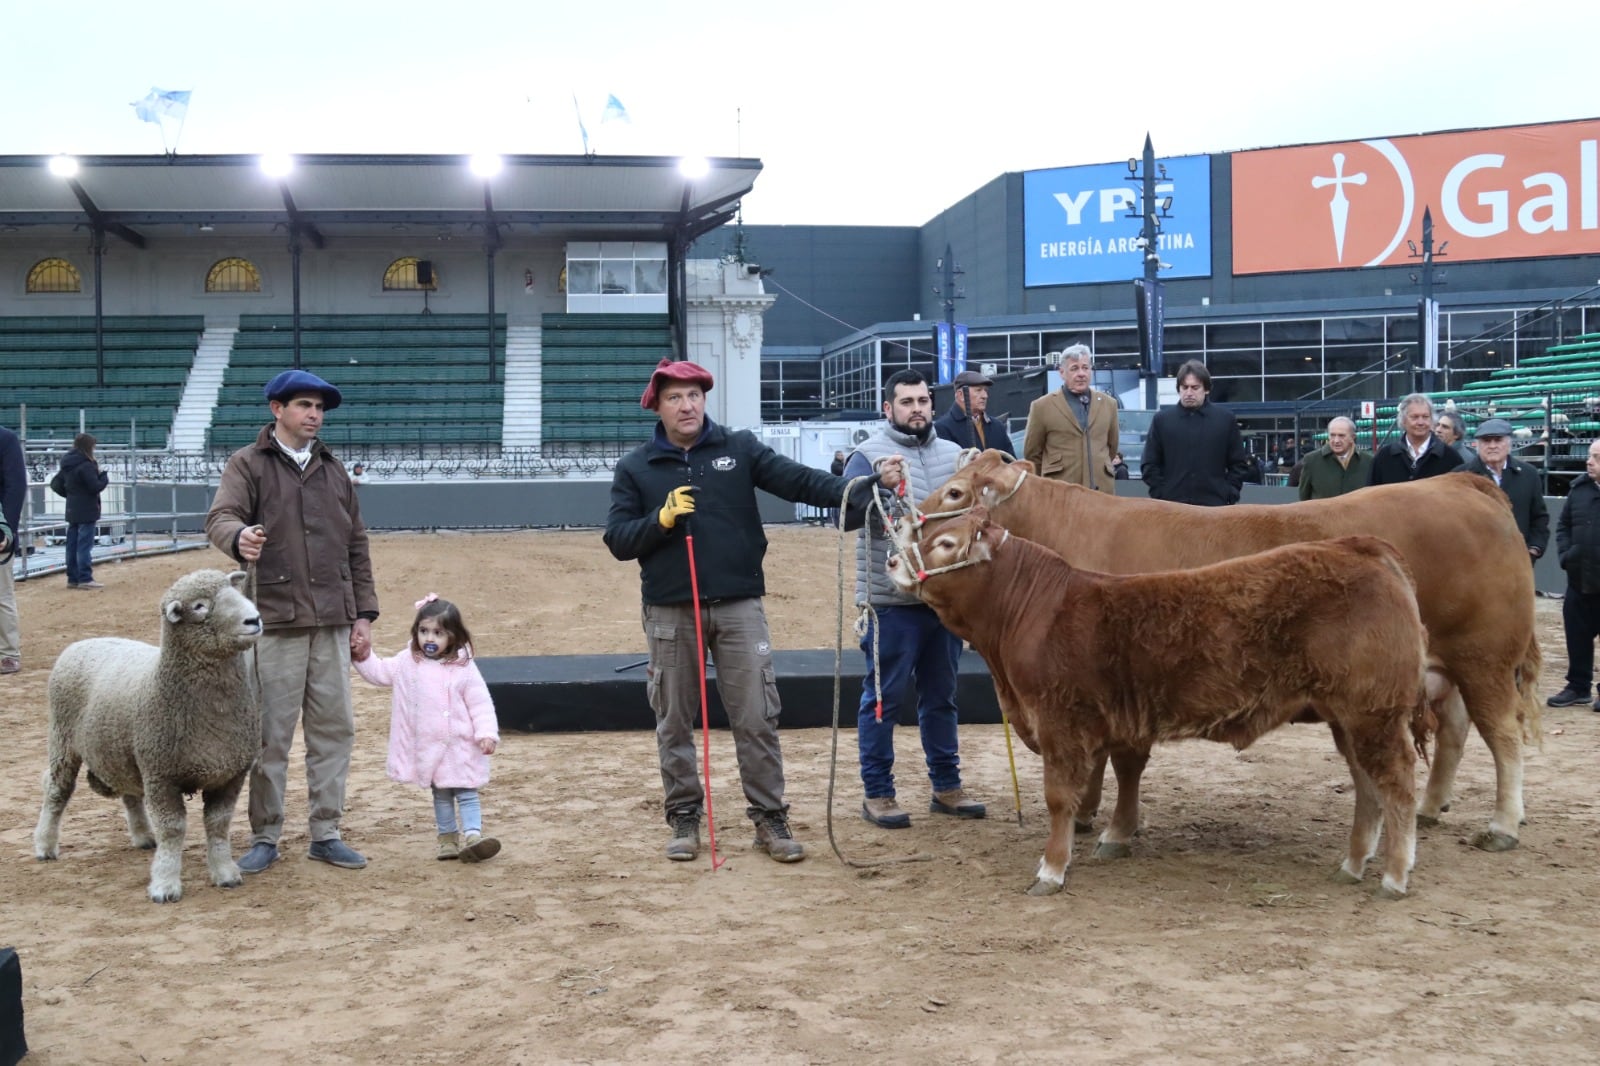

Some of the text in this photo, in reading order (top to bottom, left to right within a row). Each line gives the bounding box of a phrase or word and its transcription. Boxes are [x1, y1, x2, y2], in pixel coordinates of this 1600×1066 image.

[1441, 139, 1598, 238] Gal
[1041, 233, 1194, 258] ENERGÍA ARGTINA
